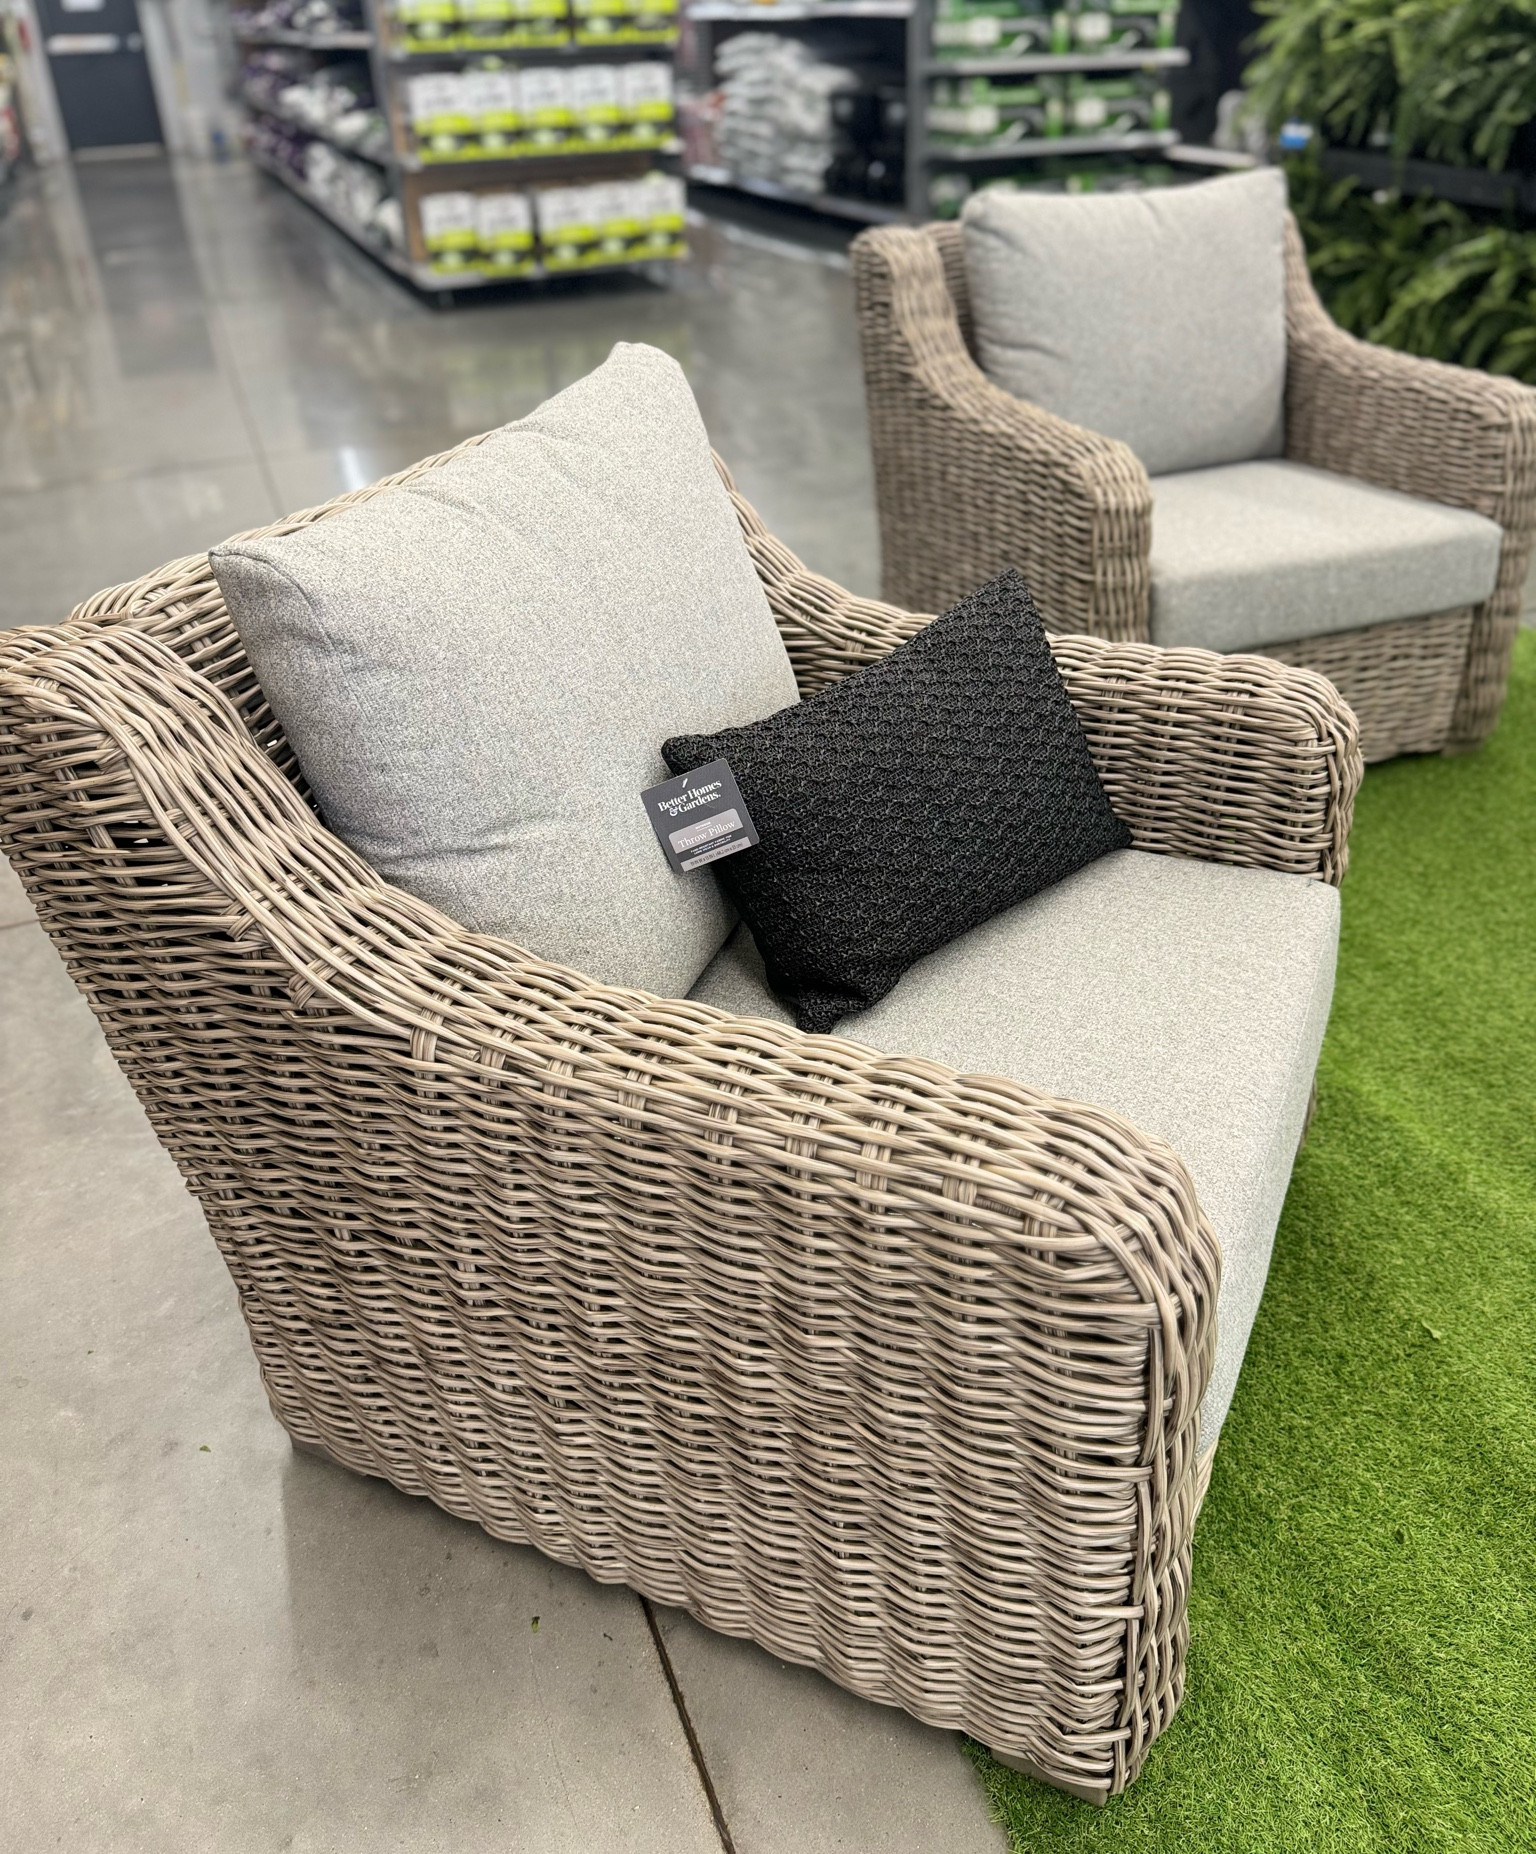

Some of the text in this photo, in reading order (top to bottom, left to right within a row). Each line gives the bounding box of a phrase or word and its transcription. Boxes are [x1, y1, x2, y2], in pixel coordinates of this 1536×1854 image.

[657, 780, 722, 812] Better Homes
[678, 831, 708, 848] Throw
[708, 821, 736, 837] Pillow
